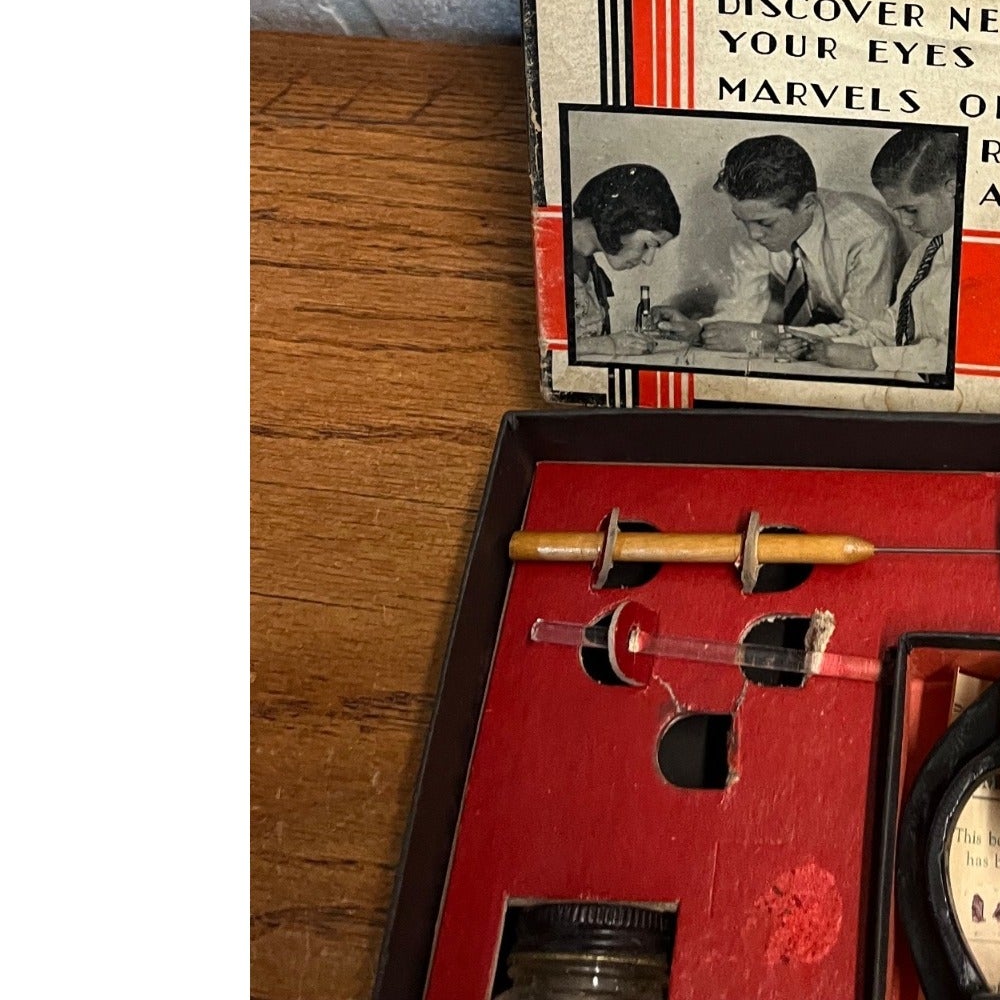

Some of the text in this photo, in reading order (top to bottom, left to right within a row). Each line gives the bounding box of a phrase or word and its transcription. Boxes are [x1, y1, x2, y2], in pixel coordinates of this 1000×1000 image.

[719, 29, 975, 69] YOUR EYES
[718, 76, 921, 114] MARVELS
[954, 827, 982, 845] This
[966, 851, 989, 867] has
